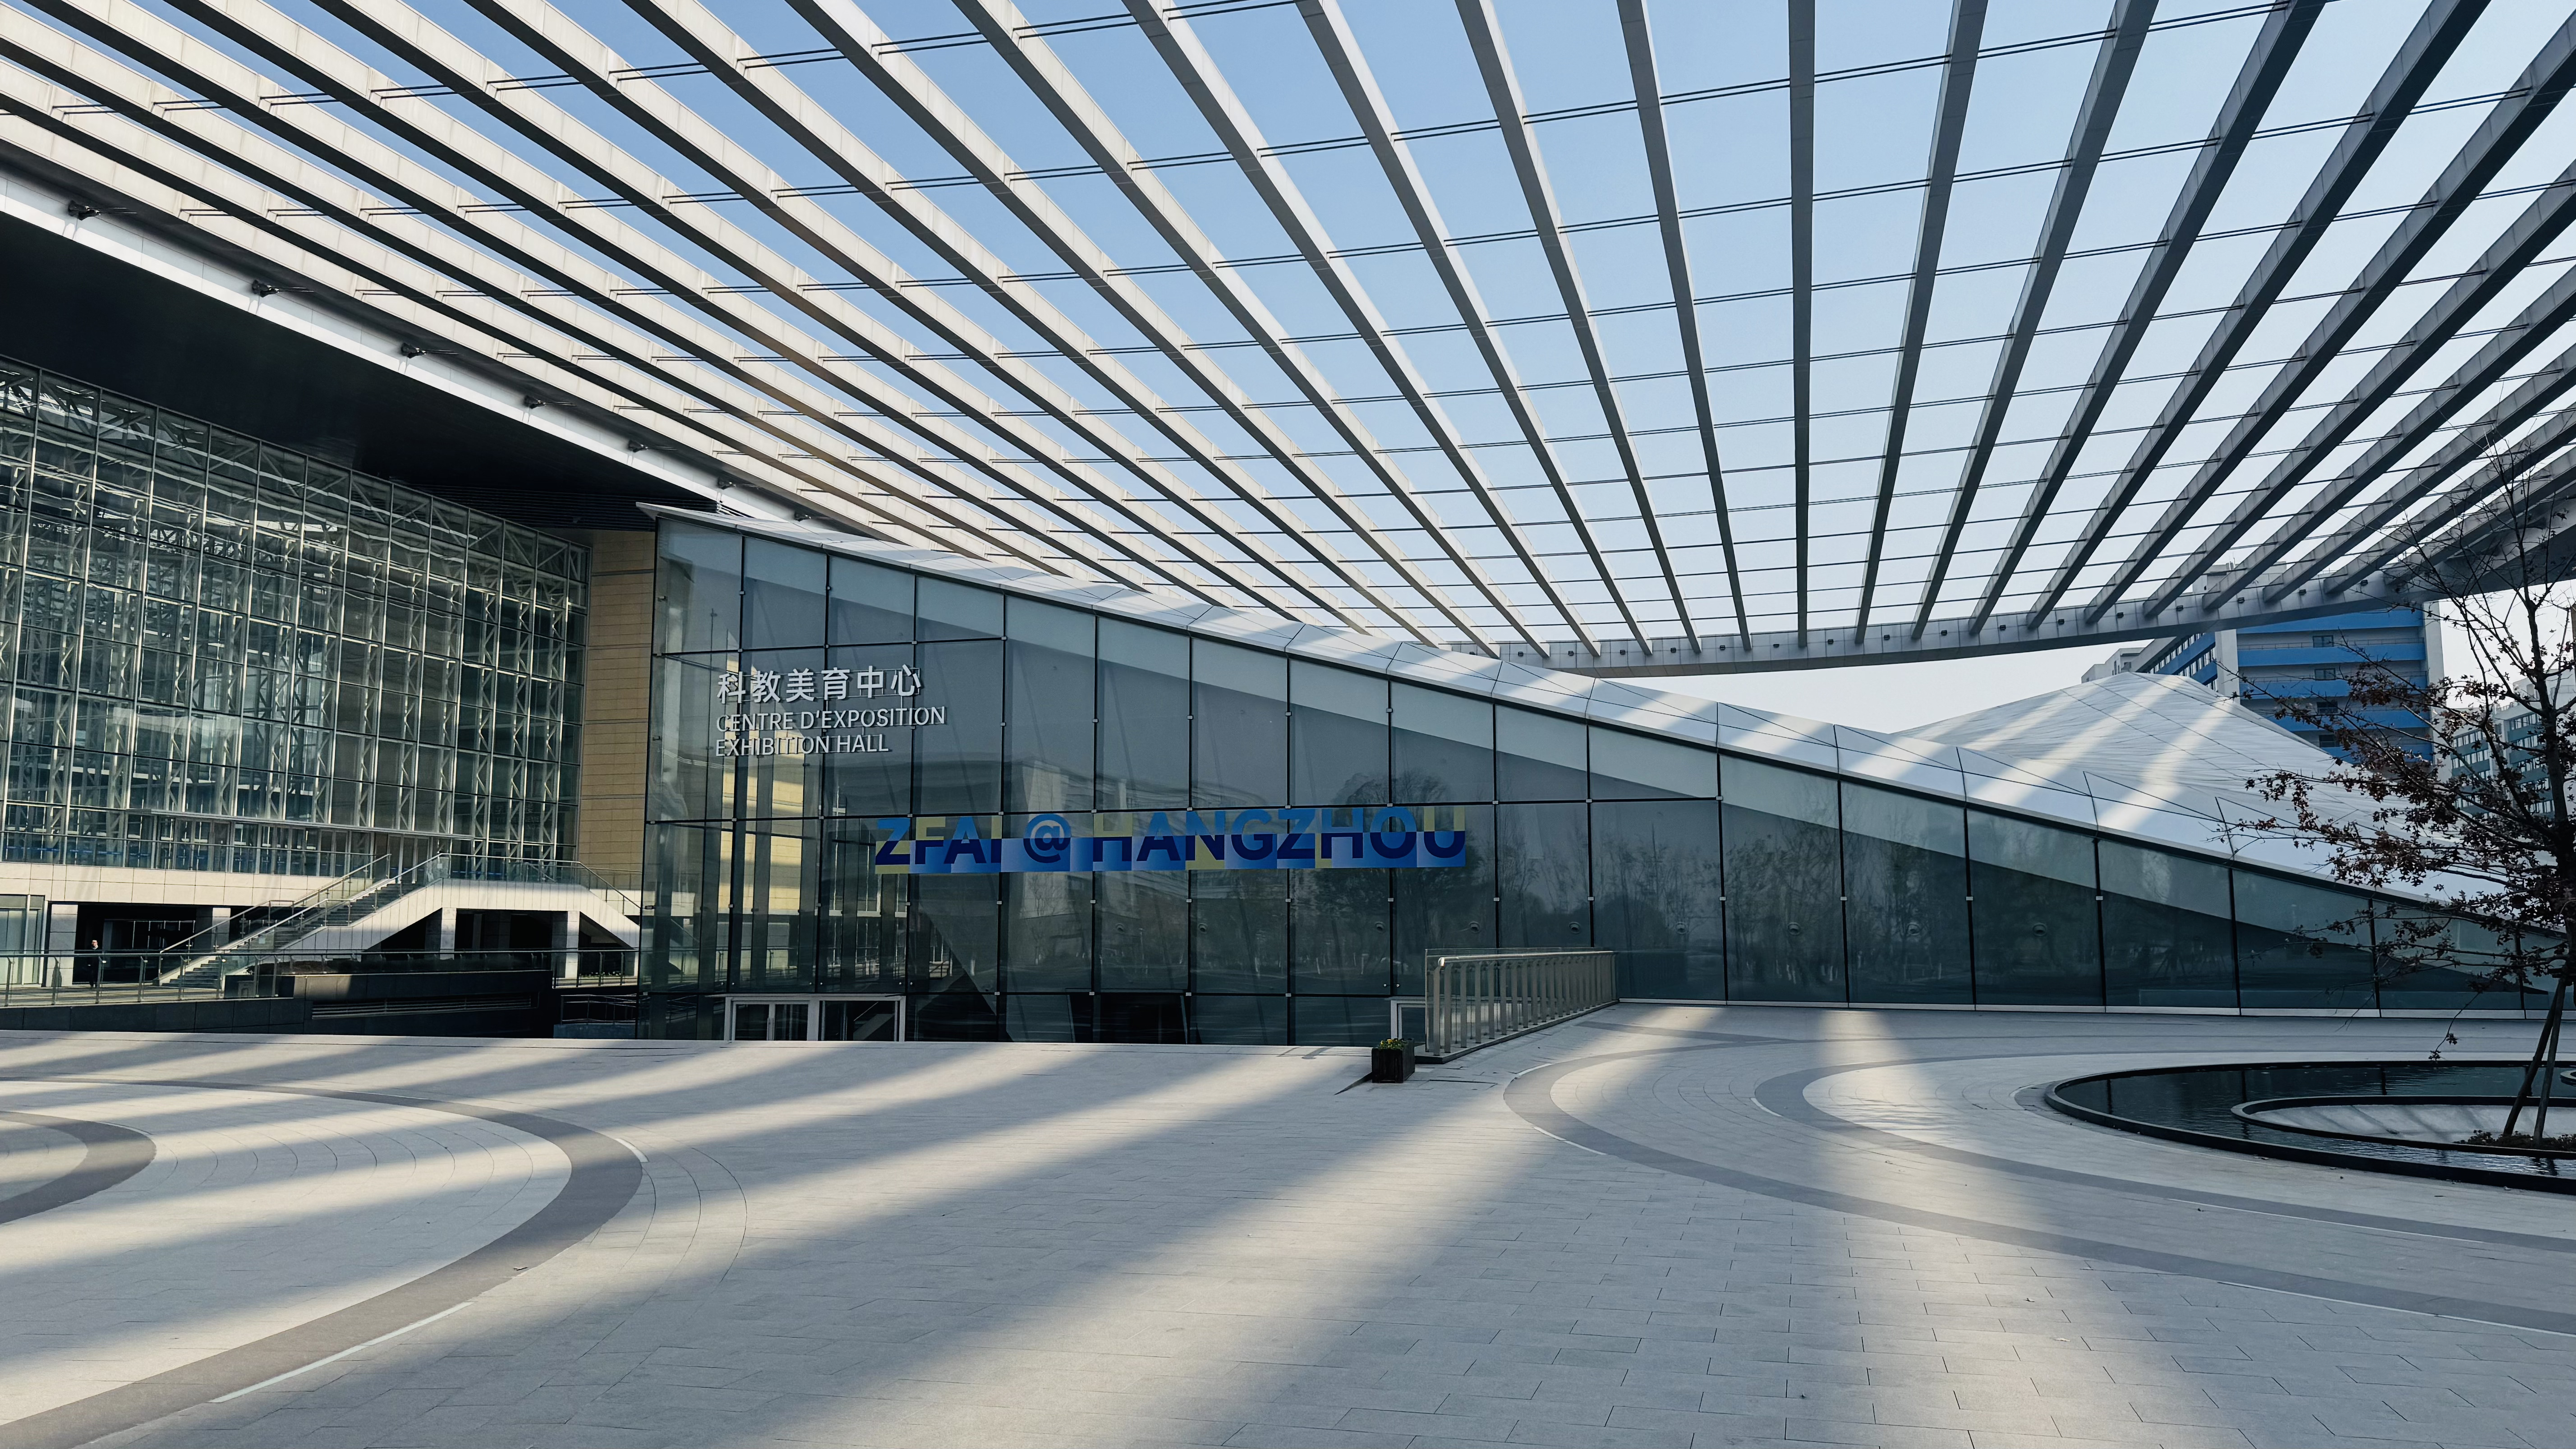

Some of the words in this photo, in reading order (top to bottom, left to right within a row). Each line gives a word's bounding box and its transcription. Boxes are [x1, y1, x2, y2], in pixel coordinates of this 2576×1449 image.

[717, 664, 921, 704] 科教美育中心
[716, 712, 794, 732] CENTRE
[800, 706, 946, 729] D'EXPOSITION
[716, 736, 829, 757] EXHIBITION
[837, 734, 889, 753] HALL
[875, 815, 1002, 865] ZFAI
[1093, 806, 1465, 862] HANGZHOU
